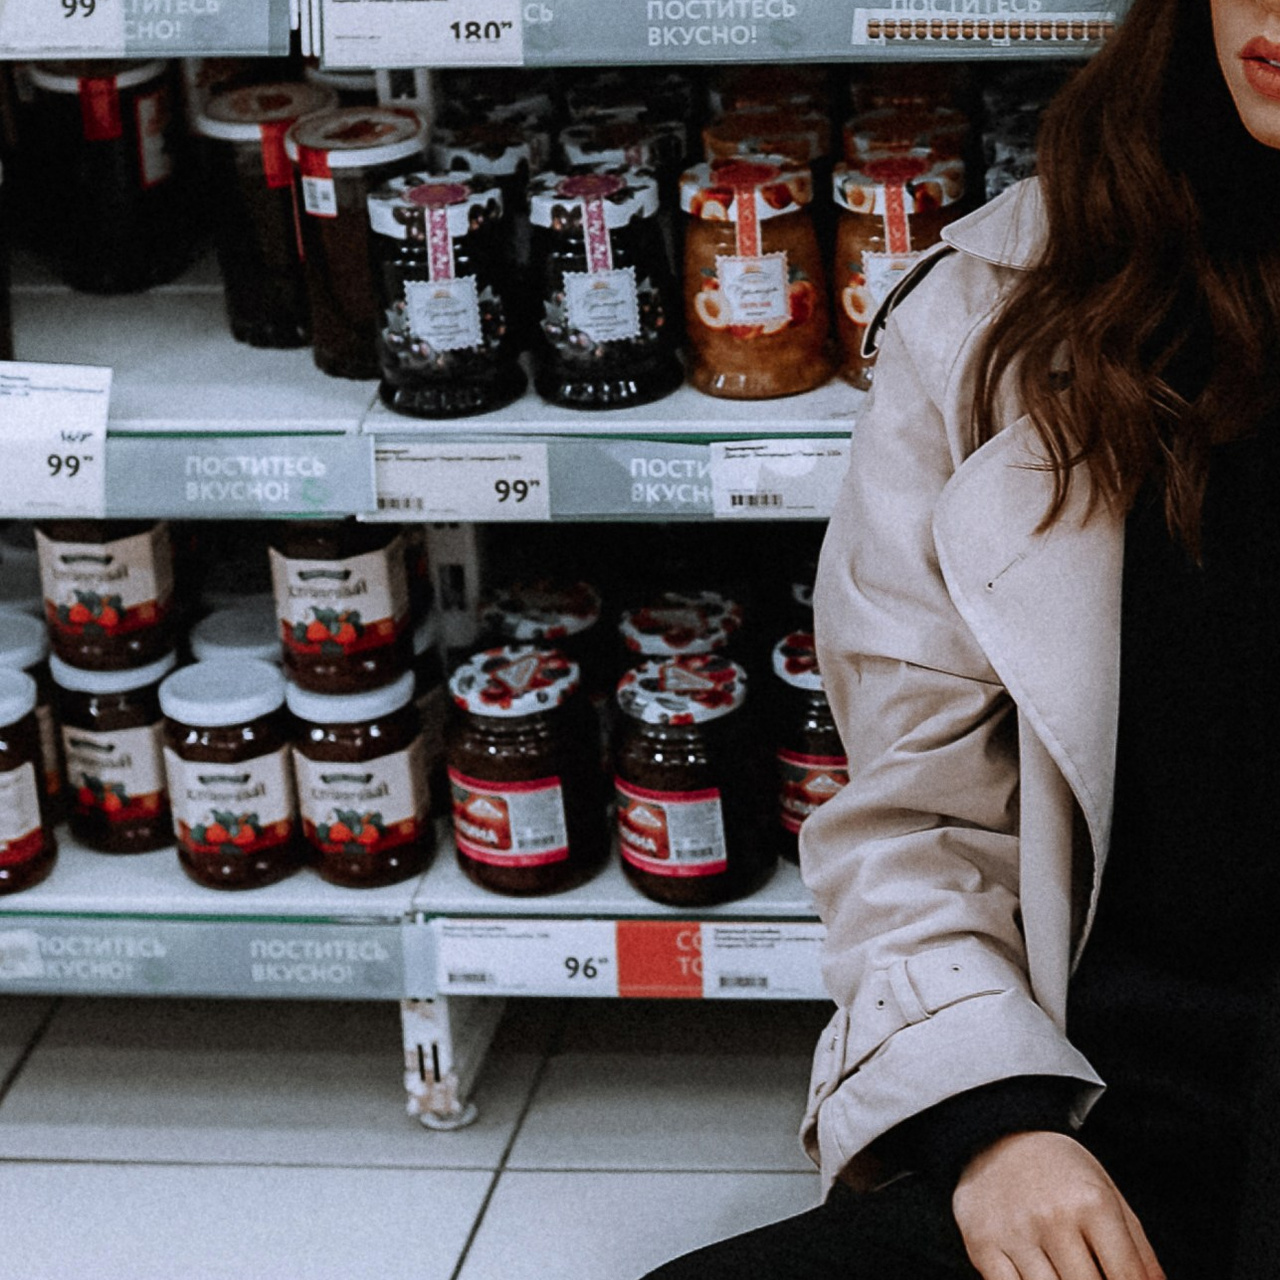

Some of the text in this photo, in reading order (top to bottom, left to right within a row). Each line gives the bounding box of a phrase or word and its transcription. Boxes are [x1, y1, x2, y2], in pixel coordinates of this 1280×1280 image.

[450, 21, 500, 40] 180
[648, 25, 757, 46] ВКУСНО!
[47, 454, 81, 478] 99
[184, 455, 326, 478] ПОСТИТЕСЬ
[184, 480, 290, 503] ВКУСНО!
[494, 479, 529, 503] 99
[249, 940, 390, 962] ПОСТИТЕСЬ
[250, 964, 354, 985] ВКУСНО!
[564, 957, 597, 979] 96
